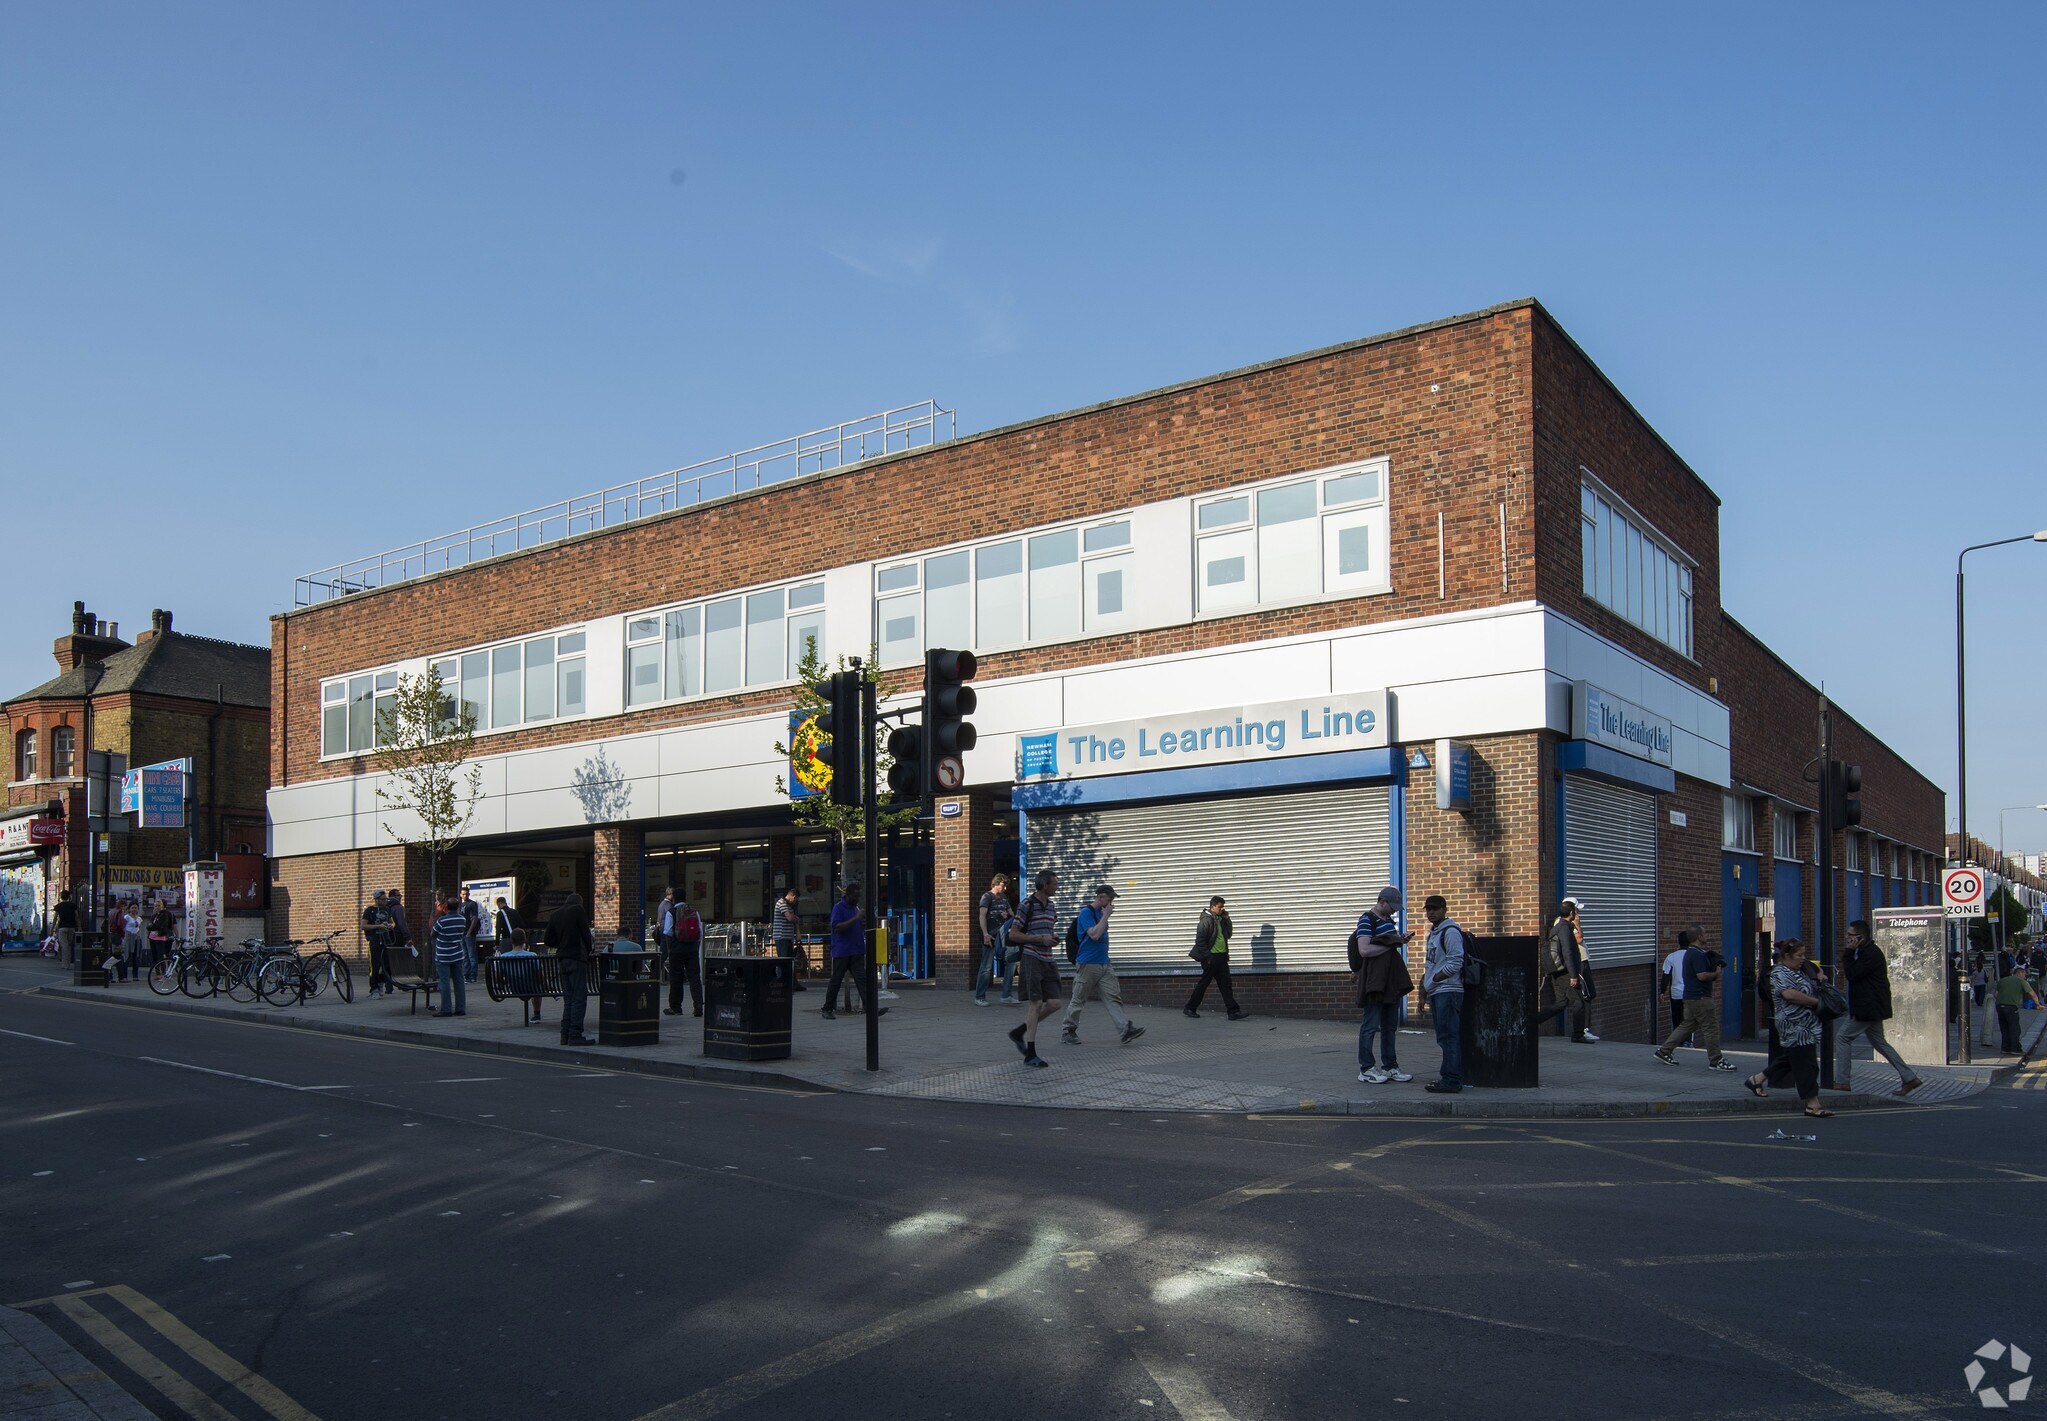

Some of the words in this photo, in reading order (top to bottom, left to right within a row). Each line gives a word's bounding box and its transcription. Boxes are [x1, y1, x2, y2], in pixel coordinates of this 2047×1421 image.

[1068, 735, 1126, 764] The
[1138, 716, 1286, 757] Learning
[1301, 706, 1375, 739] Line
[1601, 703, 1618, 735] The
[1620, 711, 1654, 750] Learning
[1654, 726, 1670, 753] Line
[1026, 749, 1053, 757] COLLEGE
[162, 772, 181, 785] CABS
[100, 868, 151, 883] MINIBUSES
[1951, 879, 1976, 894] 20
[1947, 905, 1980, 914] ZONE
[1889, 918, 1928, 928] Telephone
